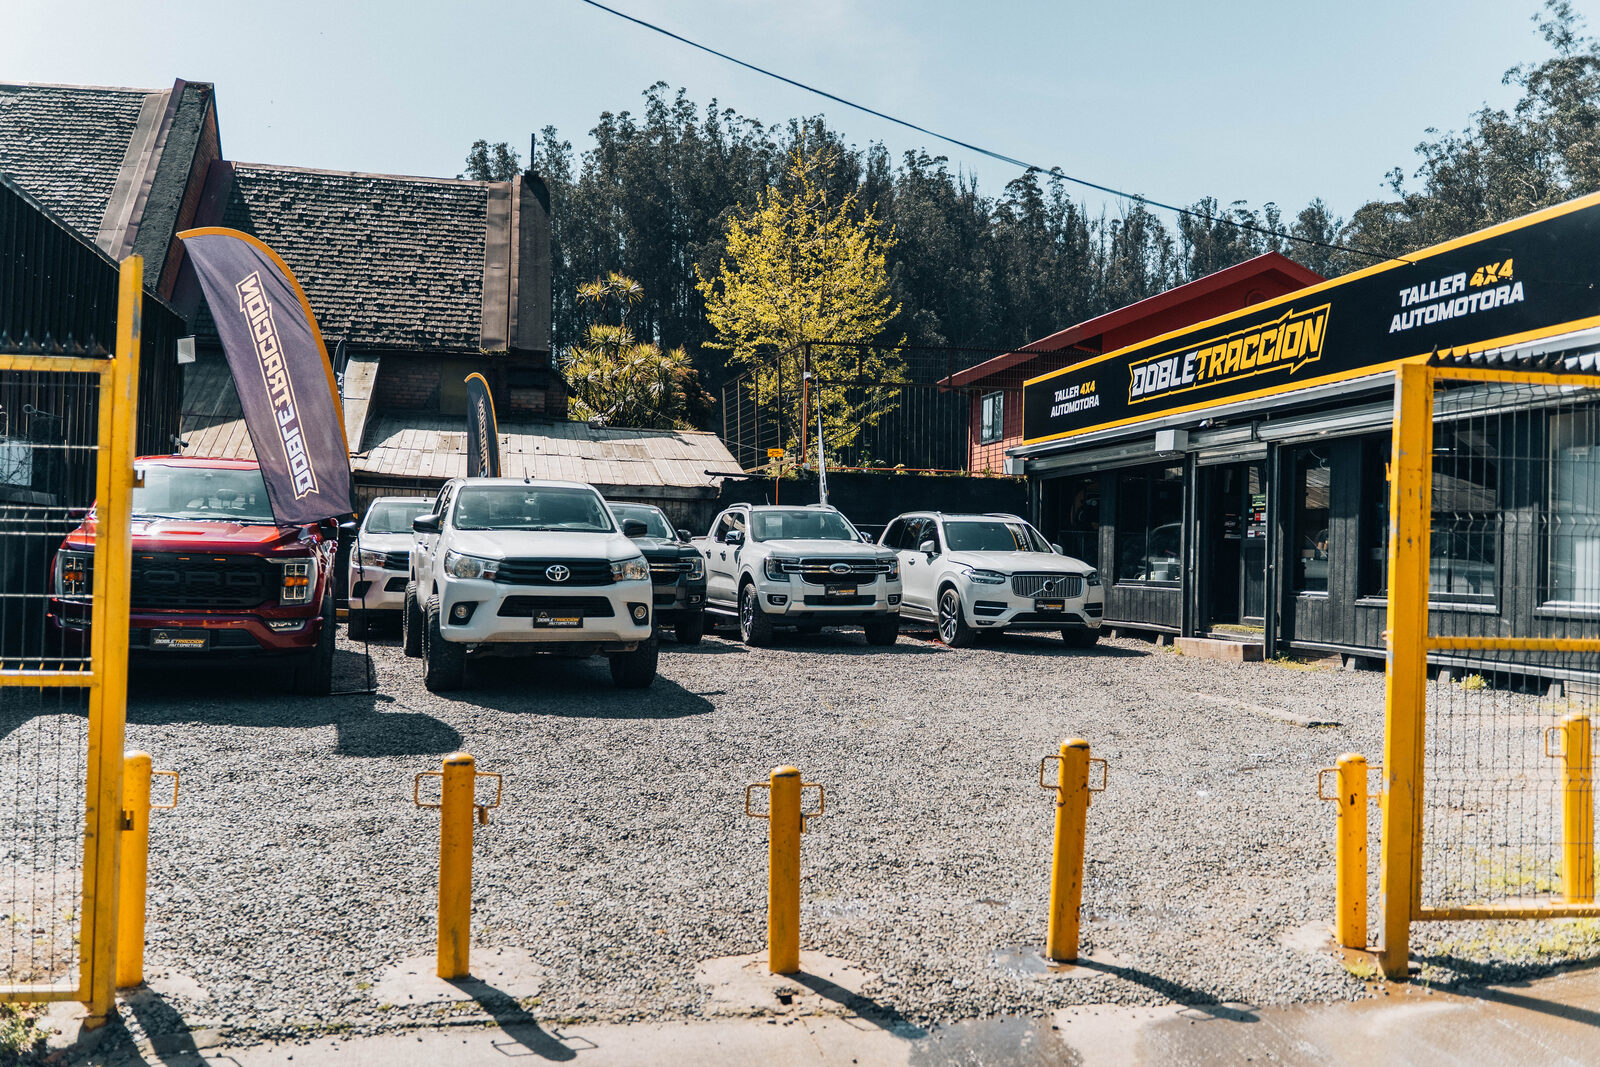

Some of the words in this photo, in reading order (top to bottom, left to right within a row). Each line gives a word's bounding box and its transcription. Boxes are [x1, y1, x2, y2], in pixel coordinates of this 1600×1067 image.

[1399, 272, 1467, 307] TALLER
[1469, 258, 1514, 287] 4X4
[1389, 281, 1525, 333] AUTOMOTORA
[1050, 394, 1100, 418] AUTOMOTORA
[1054, 384, 1080, 402] TALLER
[1080, 380, 1096, 395] 4X4
